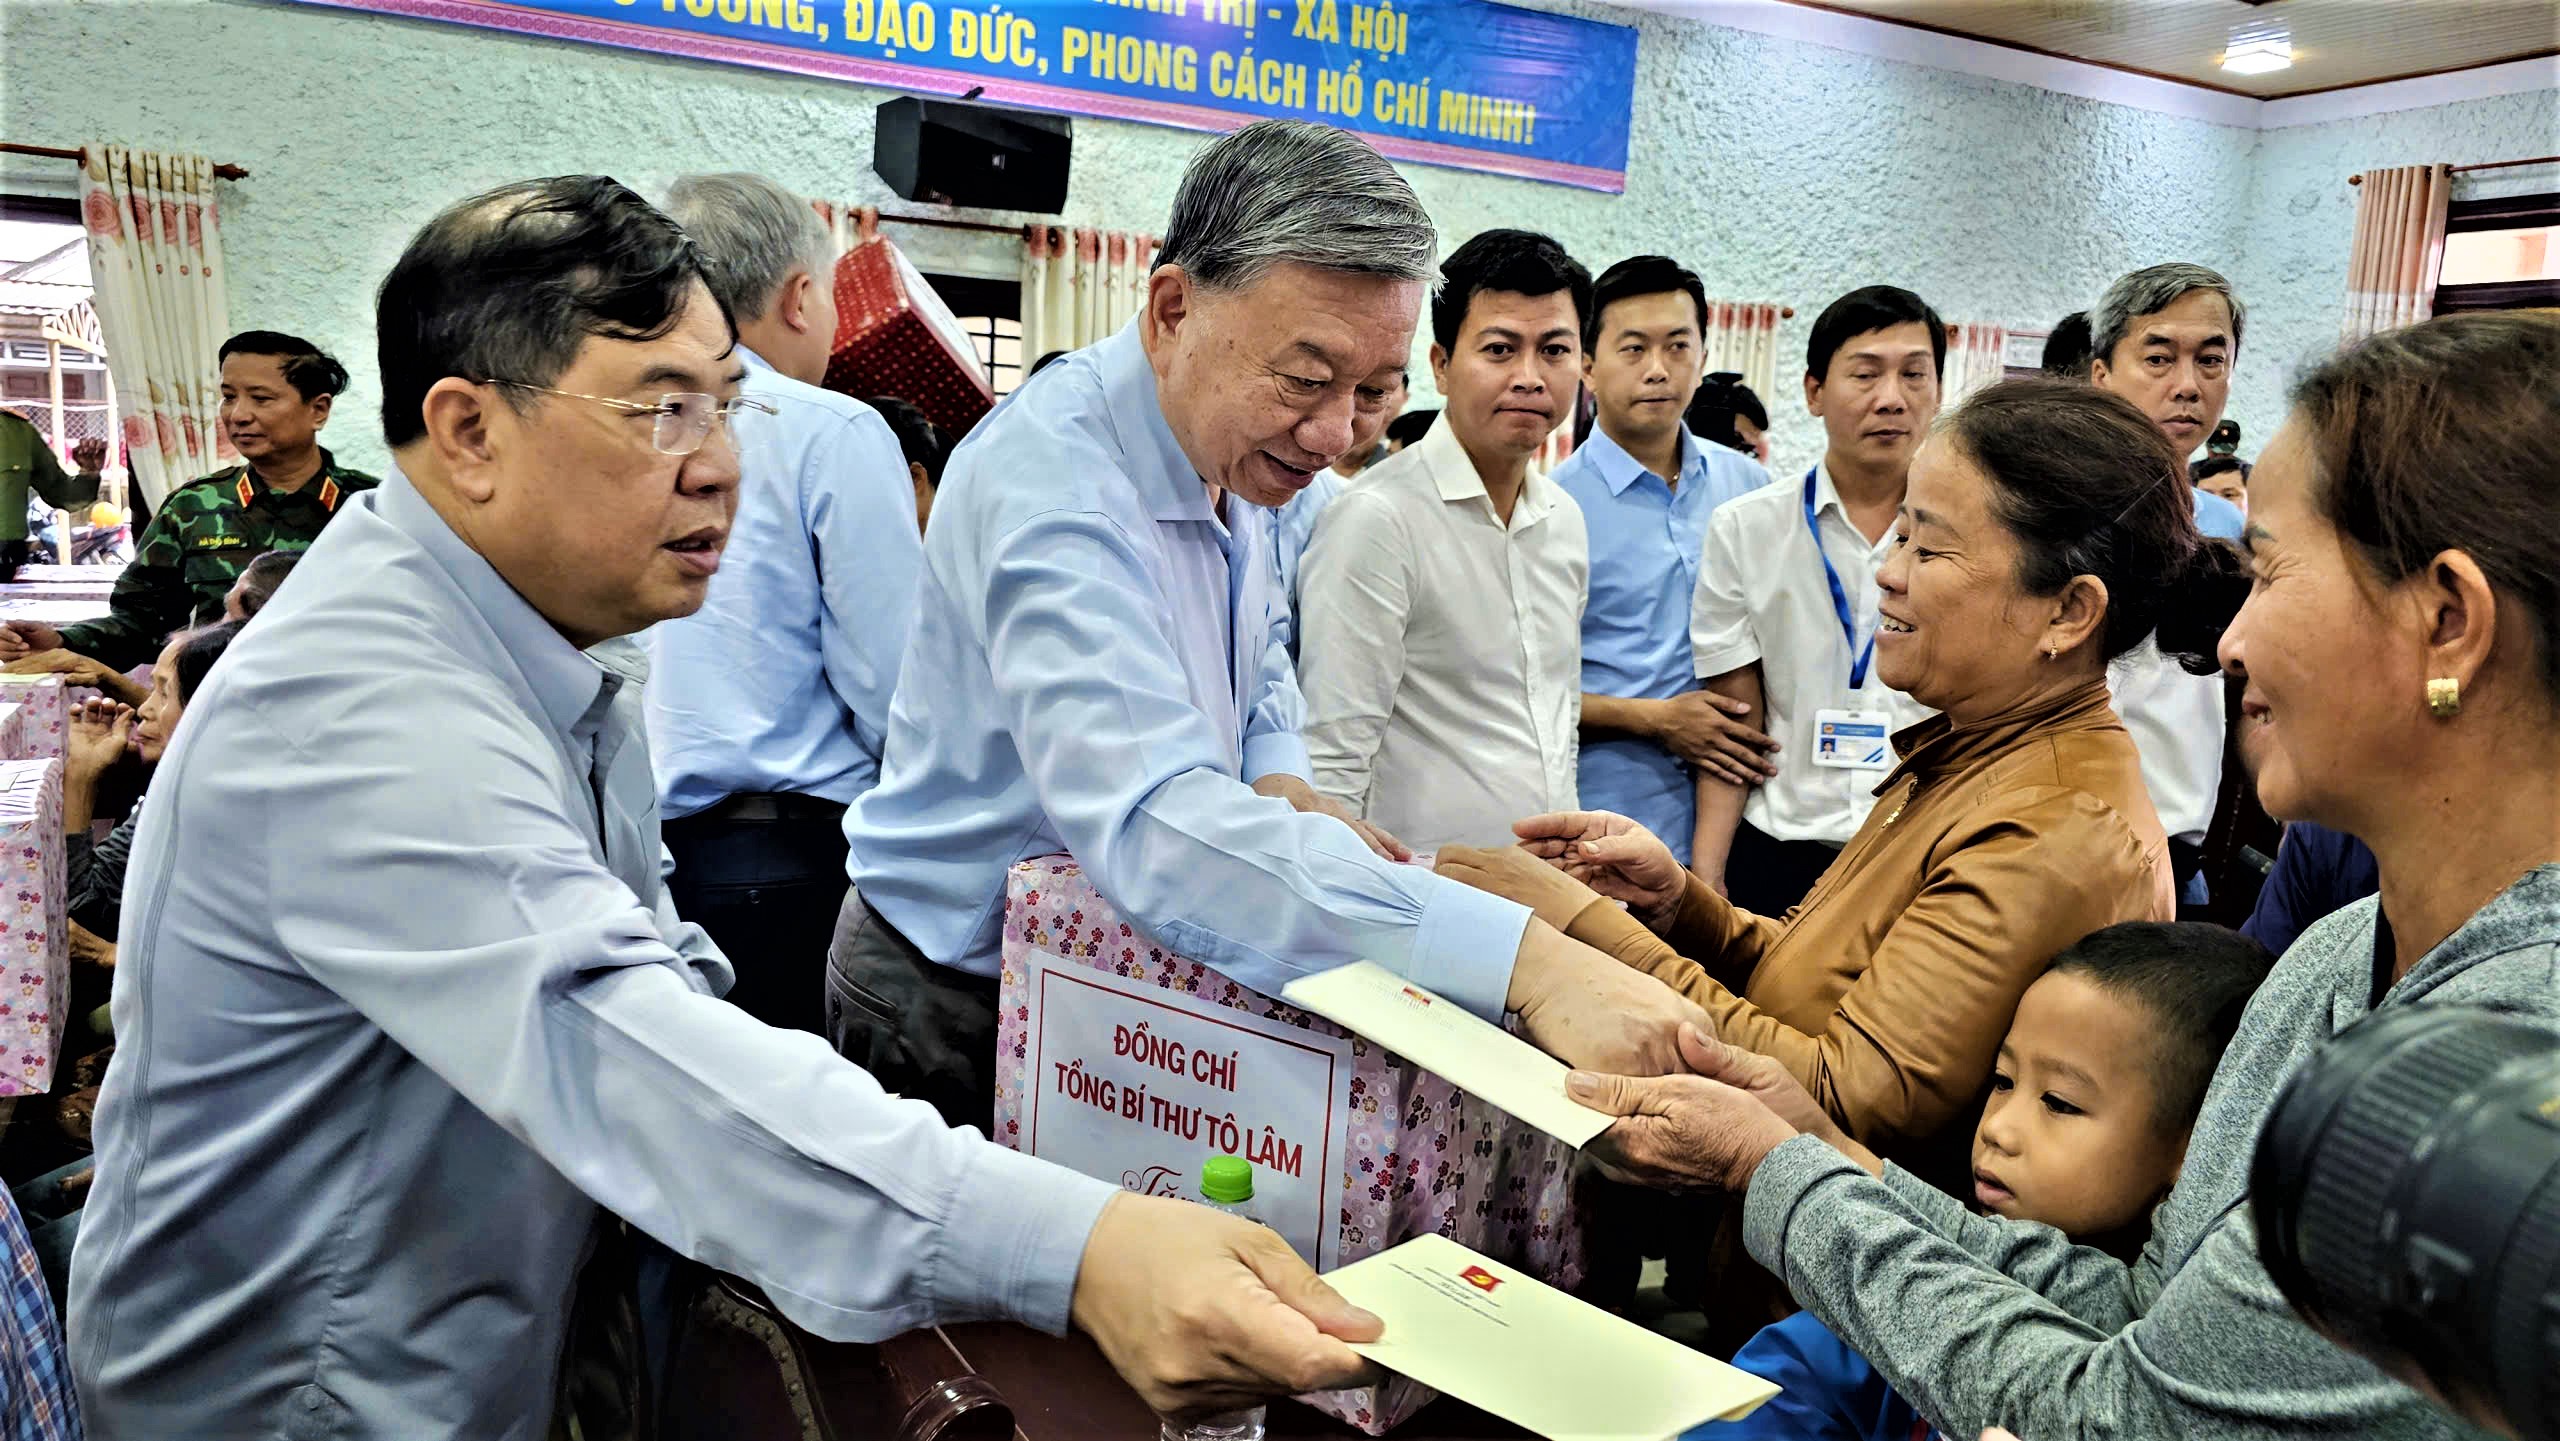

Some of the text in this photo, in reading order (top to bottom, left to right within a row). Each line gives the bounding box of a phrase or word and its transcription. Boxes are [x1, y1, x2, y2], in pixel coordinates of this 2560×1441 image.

[662, 0, 1536, 145] NG, ĐẠO ĐỨC, PHONG CÁCH HỒ CHÍ MINH!
[1350, 1, 1408, 62] HỘI
[1113, 1021, 1239, 1092] ĐỒNG CHÍ
[1054, 1058, 1303, 1178] TỔNG BÍ THƯ TÔ LÂM
